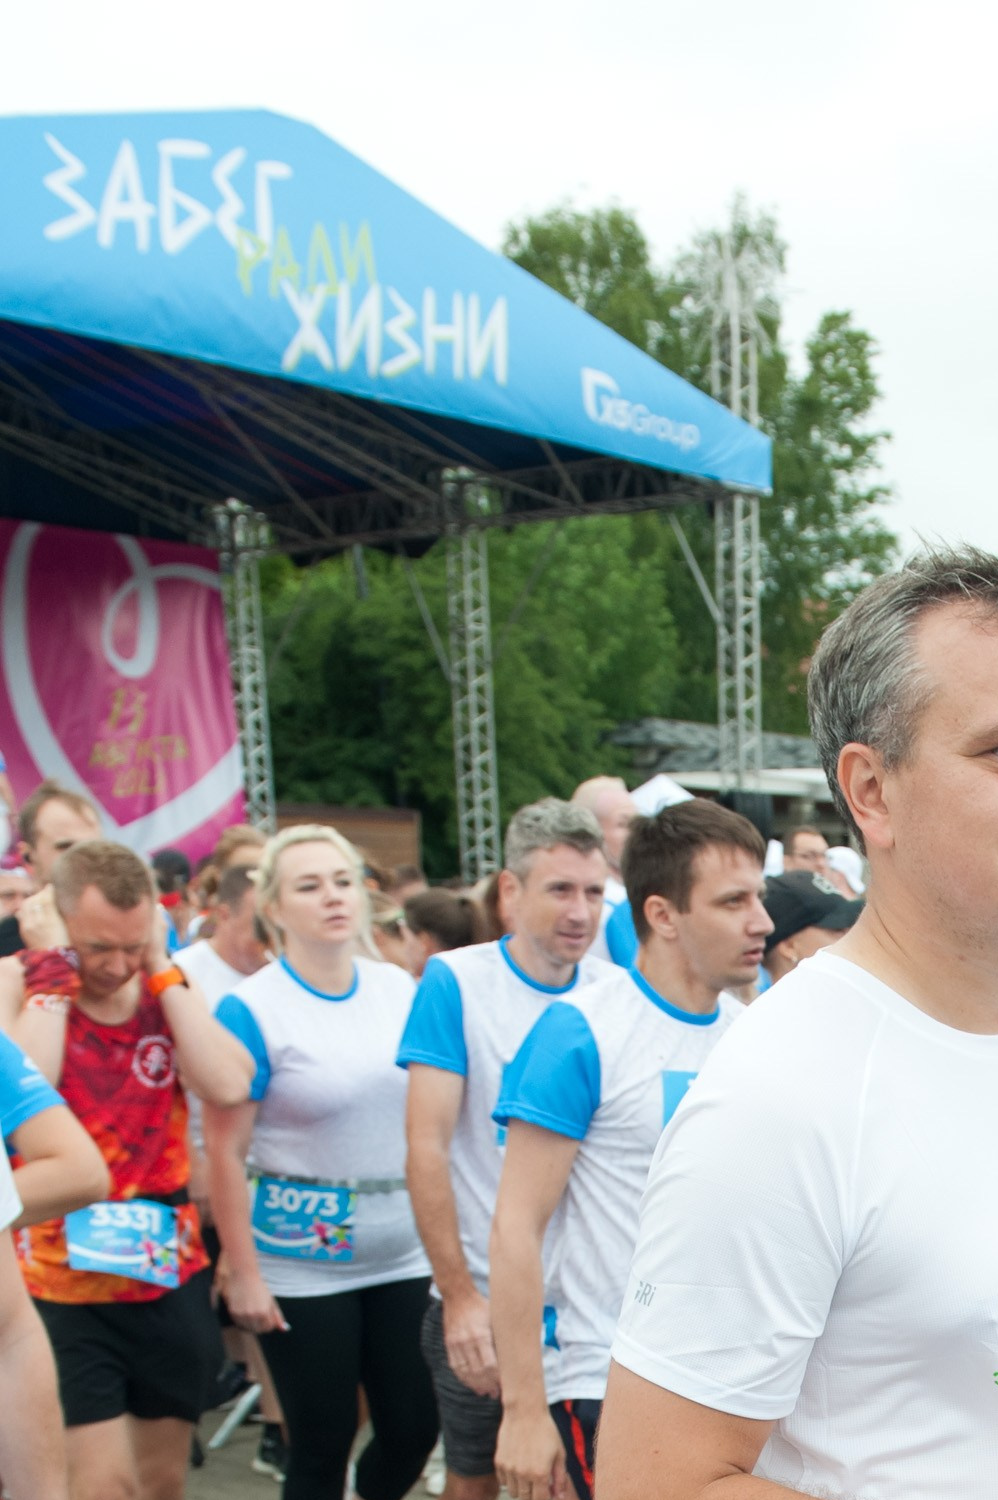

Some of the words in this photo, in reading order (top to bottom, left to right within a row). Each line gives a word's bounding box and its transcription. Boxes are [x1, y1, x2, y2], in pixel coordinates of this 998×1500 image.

[42, 131, 293, 258] ЗАБЕГ
[235, 219, 377, 299] РАДИ
[281, 279, 507, 385] ЖИЗНИ
[89, 1203, 162, 1236] 3331
[264, 1184, 340, 1217] 3073
